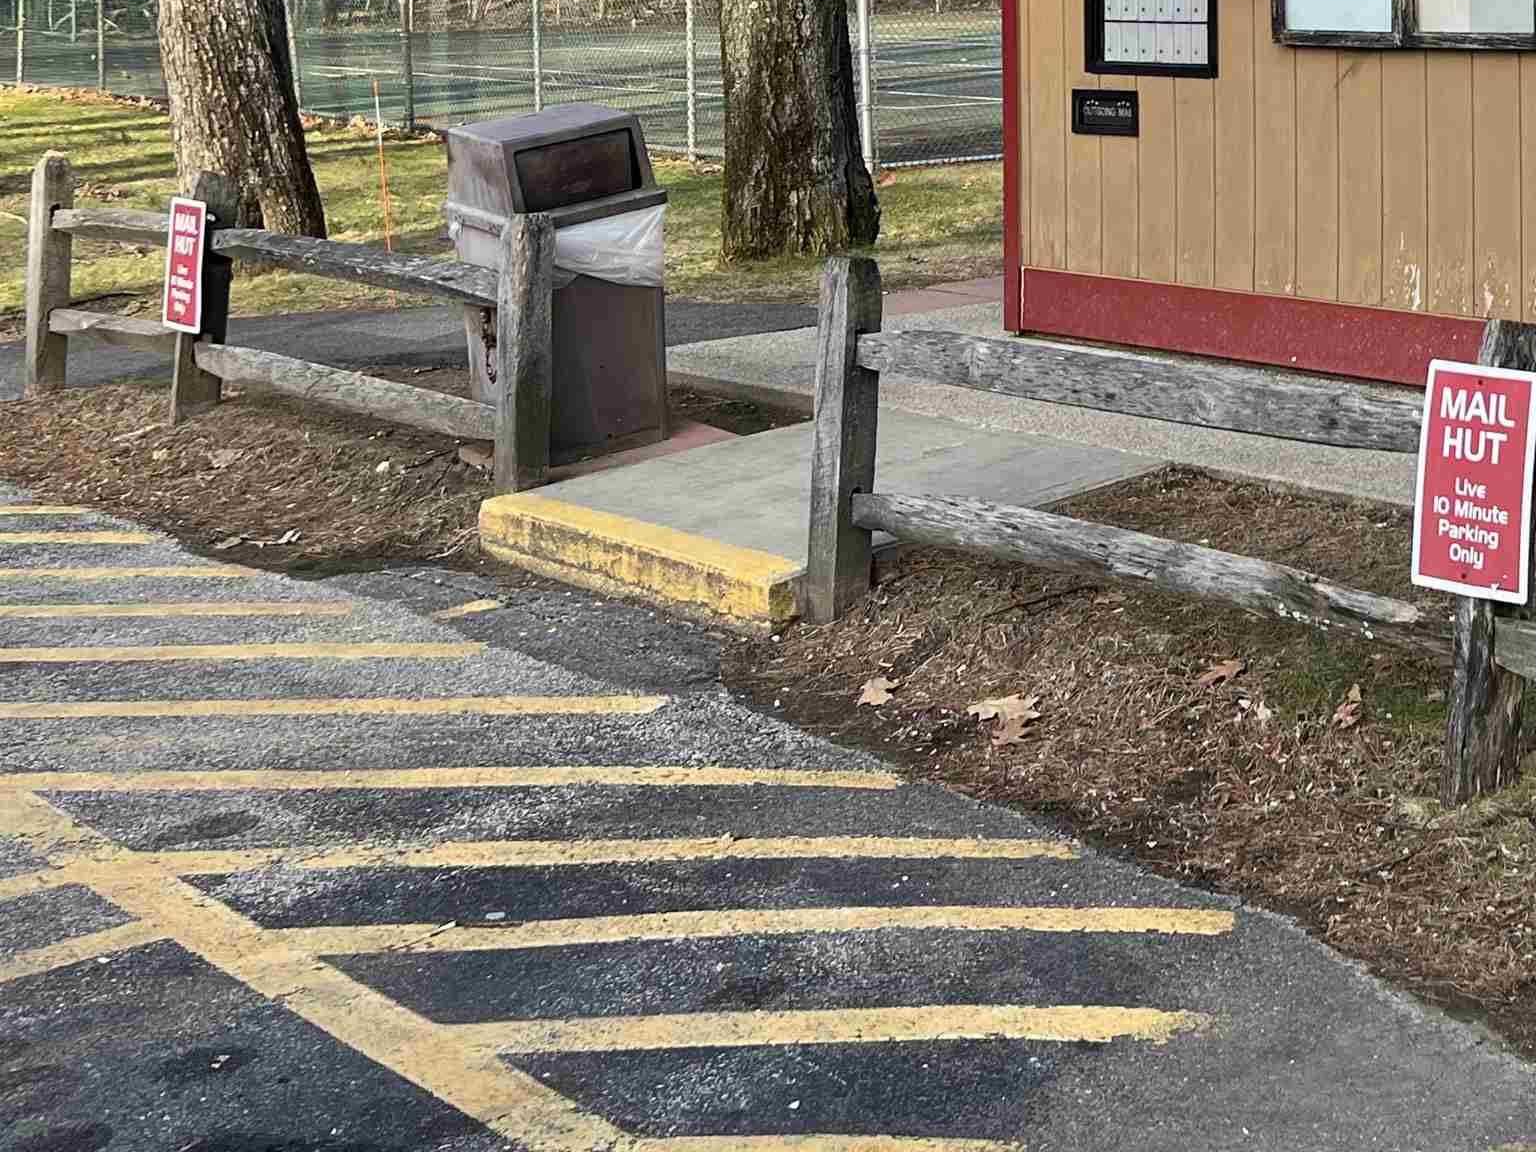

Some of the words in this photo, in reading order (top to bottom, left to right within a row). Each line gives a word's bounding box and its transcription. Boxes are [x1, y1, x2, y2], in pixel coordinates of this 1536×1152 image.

[174, 213, 198, 235] MAIL
[174, 235, 196, 256] HUT
[1440, 386, 1515, 428] MAIL
[1442, 426, 1508, 465] HUT
[1455, 477, 1487, 499] Live
[1433, 495, 1450, 514] 10
[1454, 500, 1509, 525] Minute
[1438, 519, 1499, 550] Parking
[1449, 543, 1485, 570] Only
